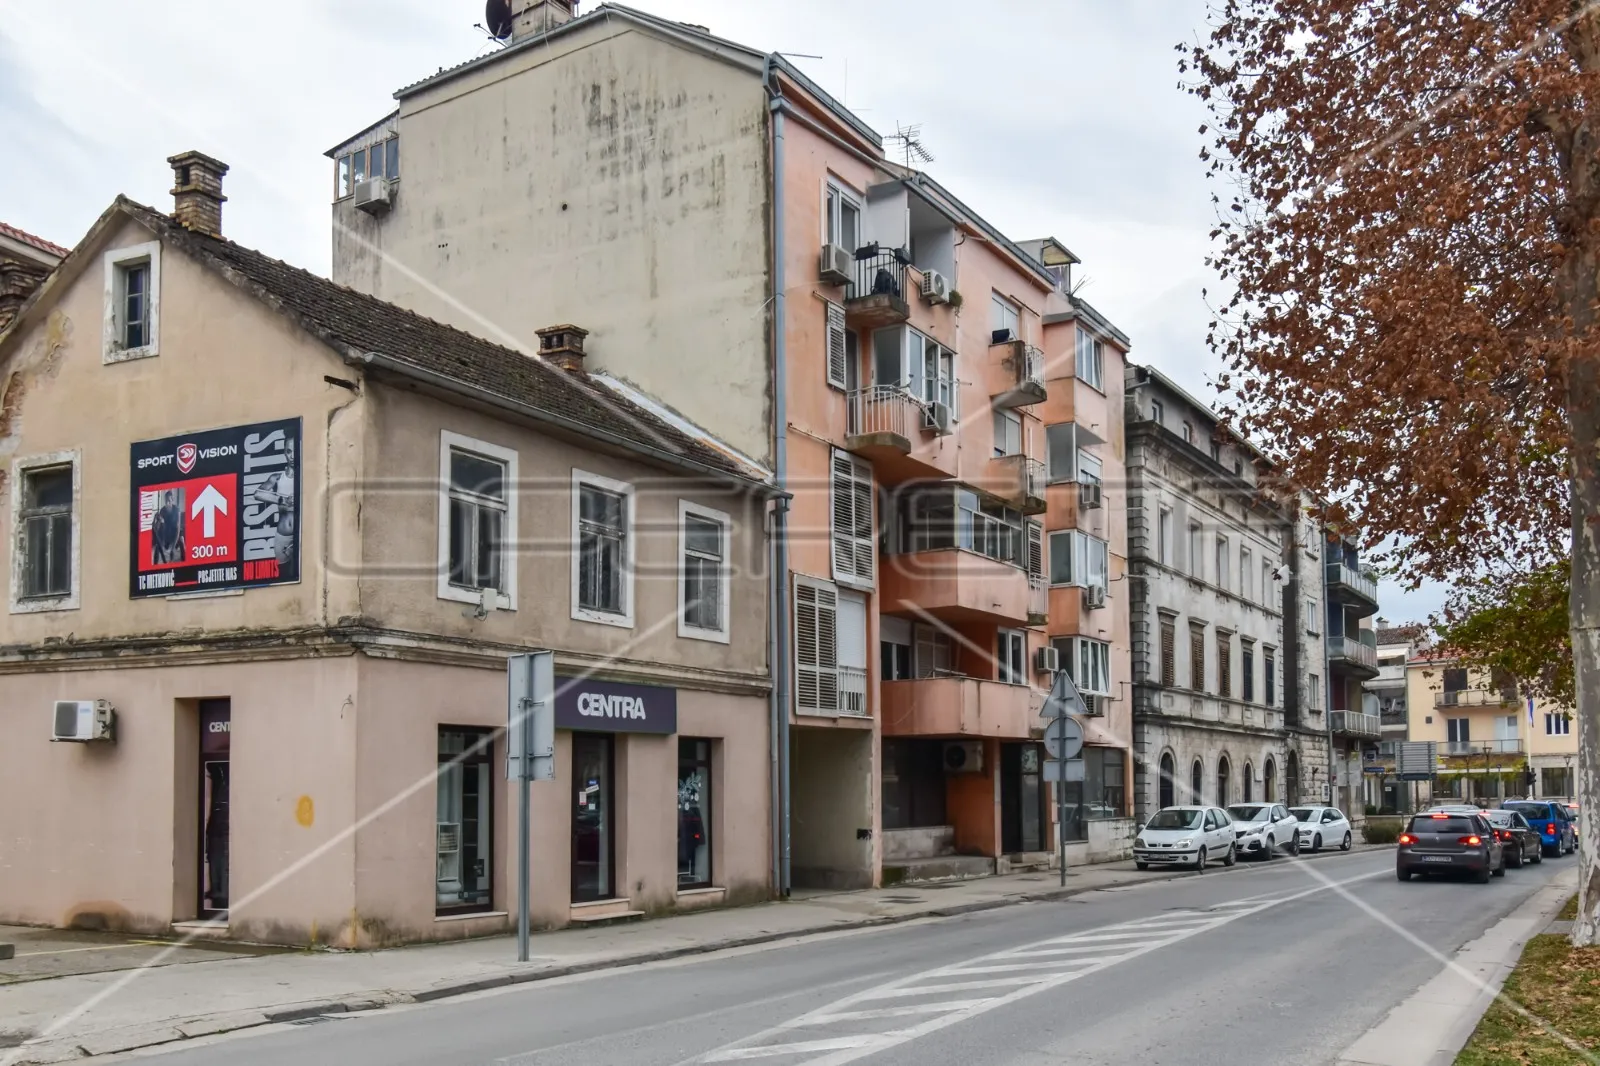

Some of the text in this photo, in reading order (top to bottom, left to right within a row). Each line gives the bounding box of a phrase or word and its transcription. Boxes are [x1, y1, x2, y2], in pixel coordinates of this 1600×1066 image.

[137, 444, 238, 468] SPORT VISION
[140, 491, 153, 532] VICTORY
[191, 545, 228, 559] 300 m
[197, 566, 238, 584] POSJETITE NAS
[577, 692, 646, 720] CENTRA
